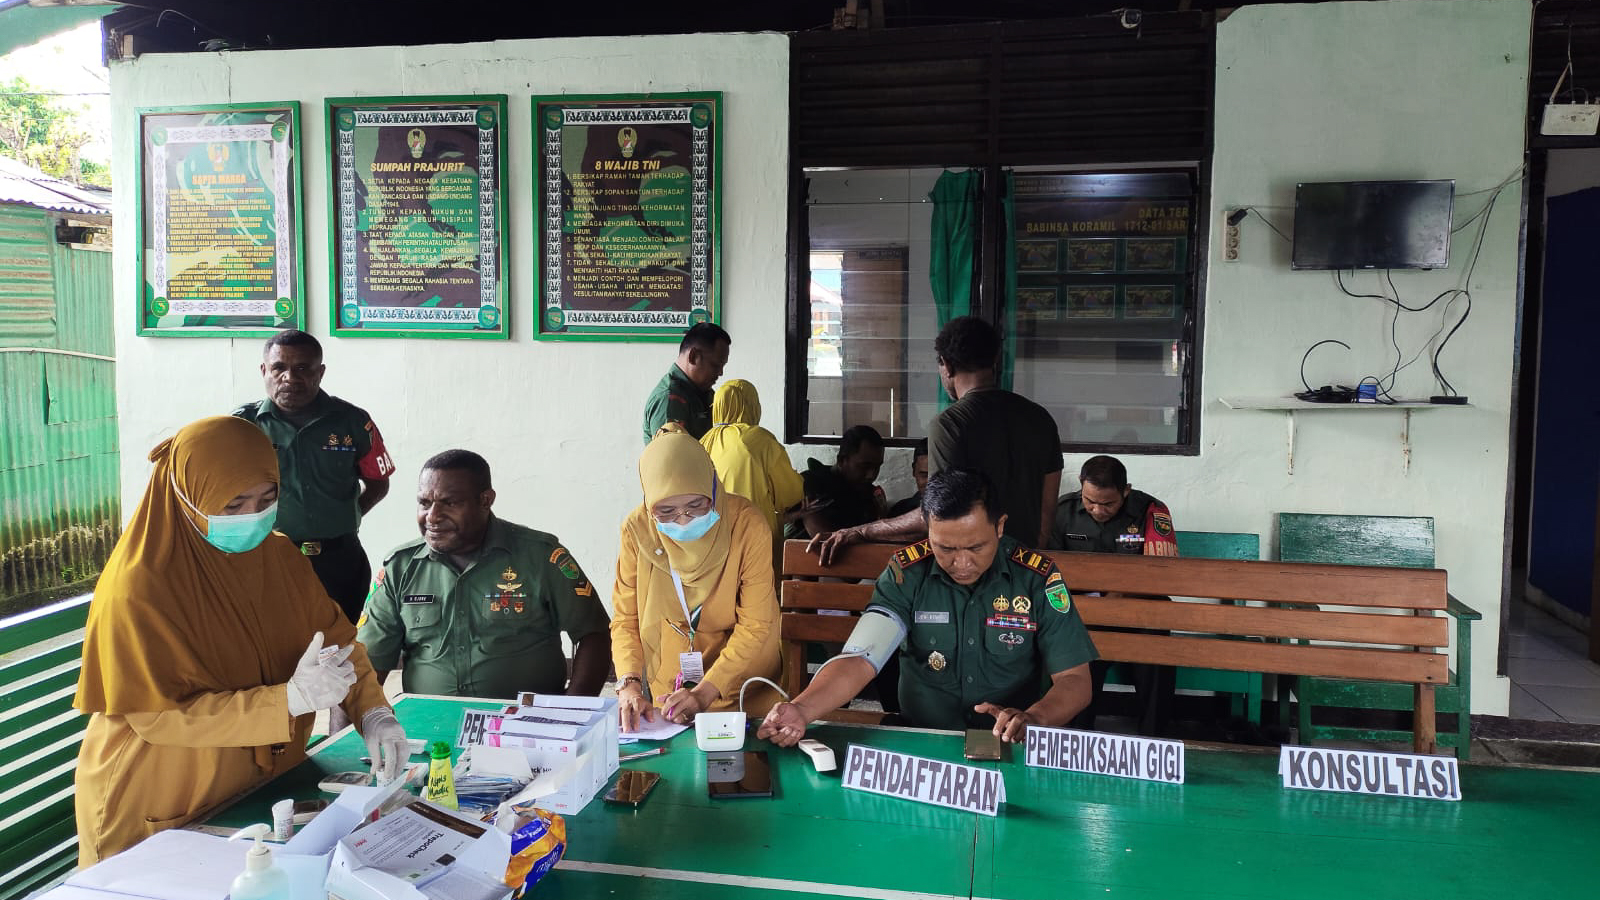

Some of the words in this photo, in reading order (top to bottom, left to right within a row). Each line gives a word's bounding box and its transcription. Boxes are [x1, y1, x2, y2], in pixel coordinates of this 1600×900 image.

[370, 162, 412, 172] SUMPAH
[414, 162, 465, 172] PRAJURIT
[595, 160, 601, 170] 8
[604, 160, 639, 170] WAJIB
[642, 160, 660, 170] TNI
[1138, 208, 1166, 218] DATA
[1026, 222, 1068, 232] BABINSA
[1072, 221, 1116, 231] KORAMIL
[460, 712, 488, 746] PEN
[1028, 730, 1140, 776] PEMERIKSAAN
[1146, 742, 1180, 781] GIGI
[848, 748, 999, 812] PENDAFTARAN
[1289, 750, 1458, 798] KONSULTASI
